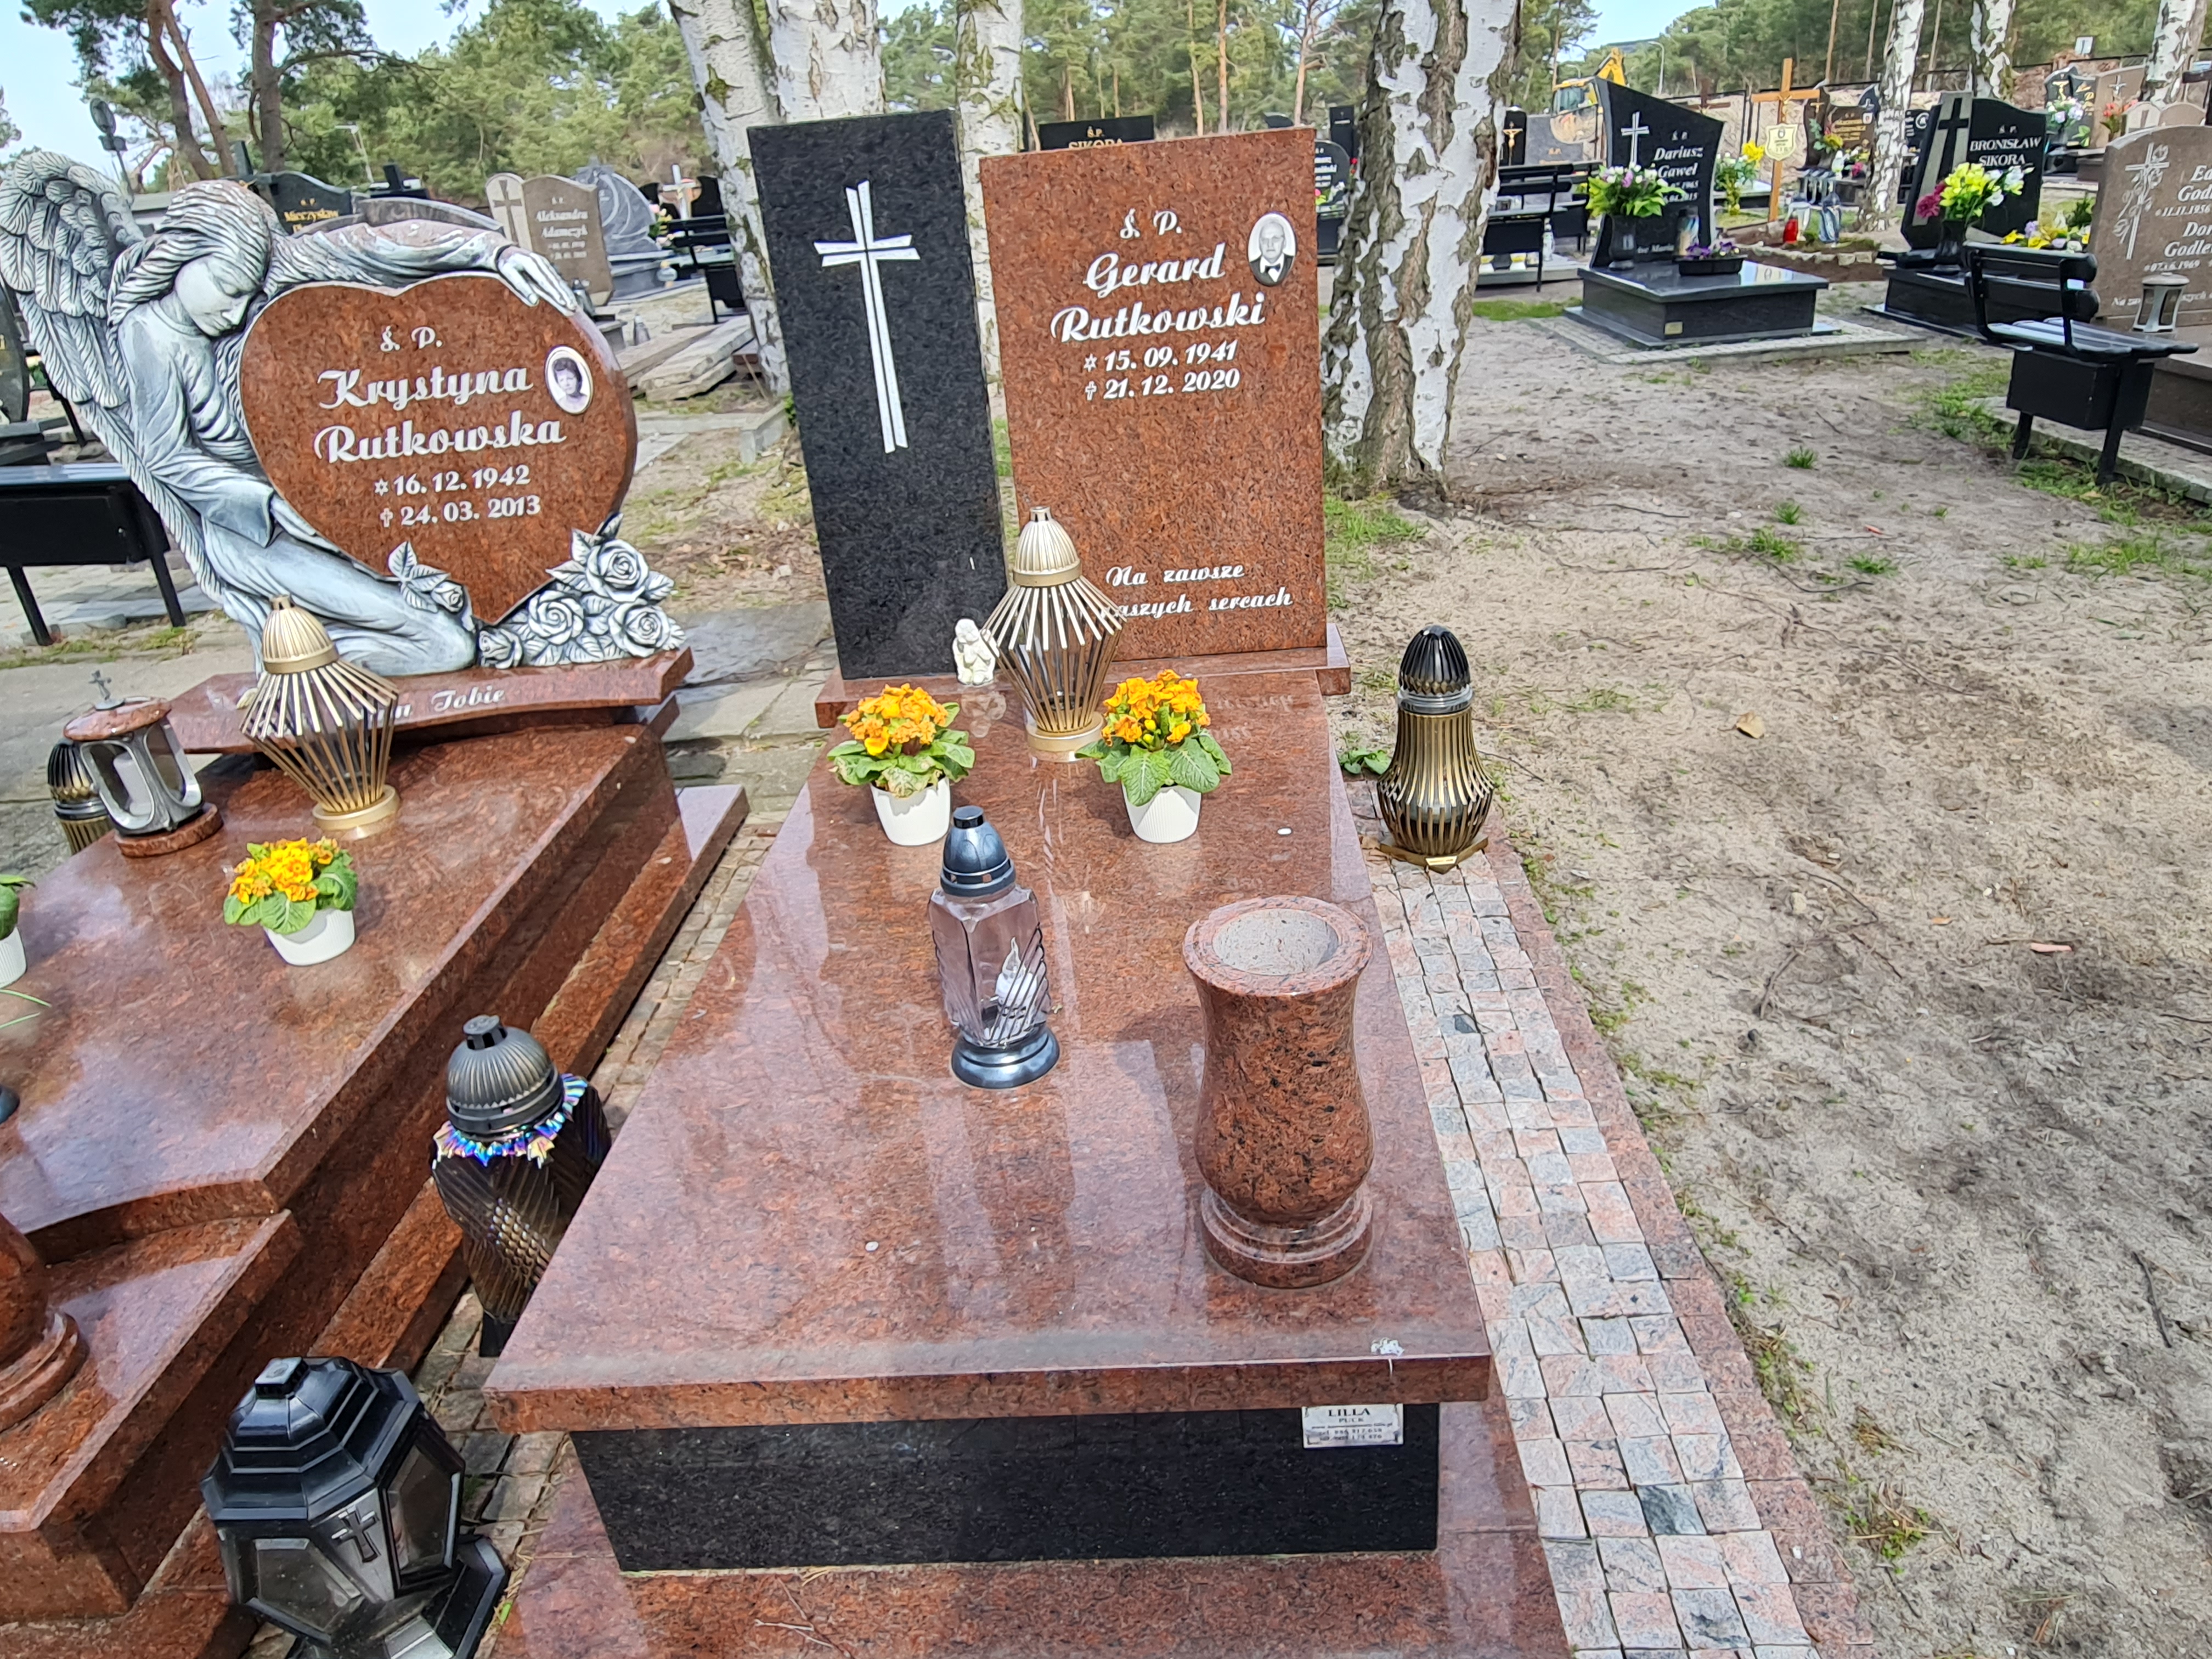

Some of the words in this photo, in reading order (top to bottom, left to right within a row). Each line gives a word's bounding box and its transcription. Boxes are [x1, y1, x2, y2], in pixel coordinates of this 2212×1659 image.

[1654, 145, 1704, 161] Dariusz
[1970, 136, 2042, 152] BRONISŁAW
[1978, 153, 2026, 167] SIKORA
[1153, 210, 1182, 236] P.
[1082, 242, 1226, 300] Gerard
[1051, 291, 1266, 343] Rutkowski
[411, 326, 443, 349] P.
[1104, 350, 1138, 373] 15.
[1143, 346, 1179, 369] 09.
[1185, 340, 1239, 365] 1941
[317, 366, 534, 411] Krystyna
[1103, 379, 1136, 400] 21.
[1141, 373, 1175, 396] 12.
[1182, 369, 1241, 392] 2020
[313, 410, 567, 464] Rutkowska
[393, 473, 427, 496] 16.
[432, 472, 467, 494] 12.
[472, 464, 532, 489] 1942
[400, 506, 439, 527] 24.
[443, 501, 480, 523] 03.
[487, 495, 541, 519] 2013
[1105, 565, 1148, 588] Na
[1163, 564, 1245, 583] zawsze
[1102, 594, 1194, 619] aszych
[1208, 586, 1293, 612] sercach
[431, 684, 506, 713] Tobie
[1328, 1408, 1370, 1417] LILLA
